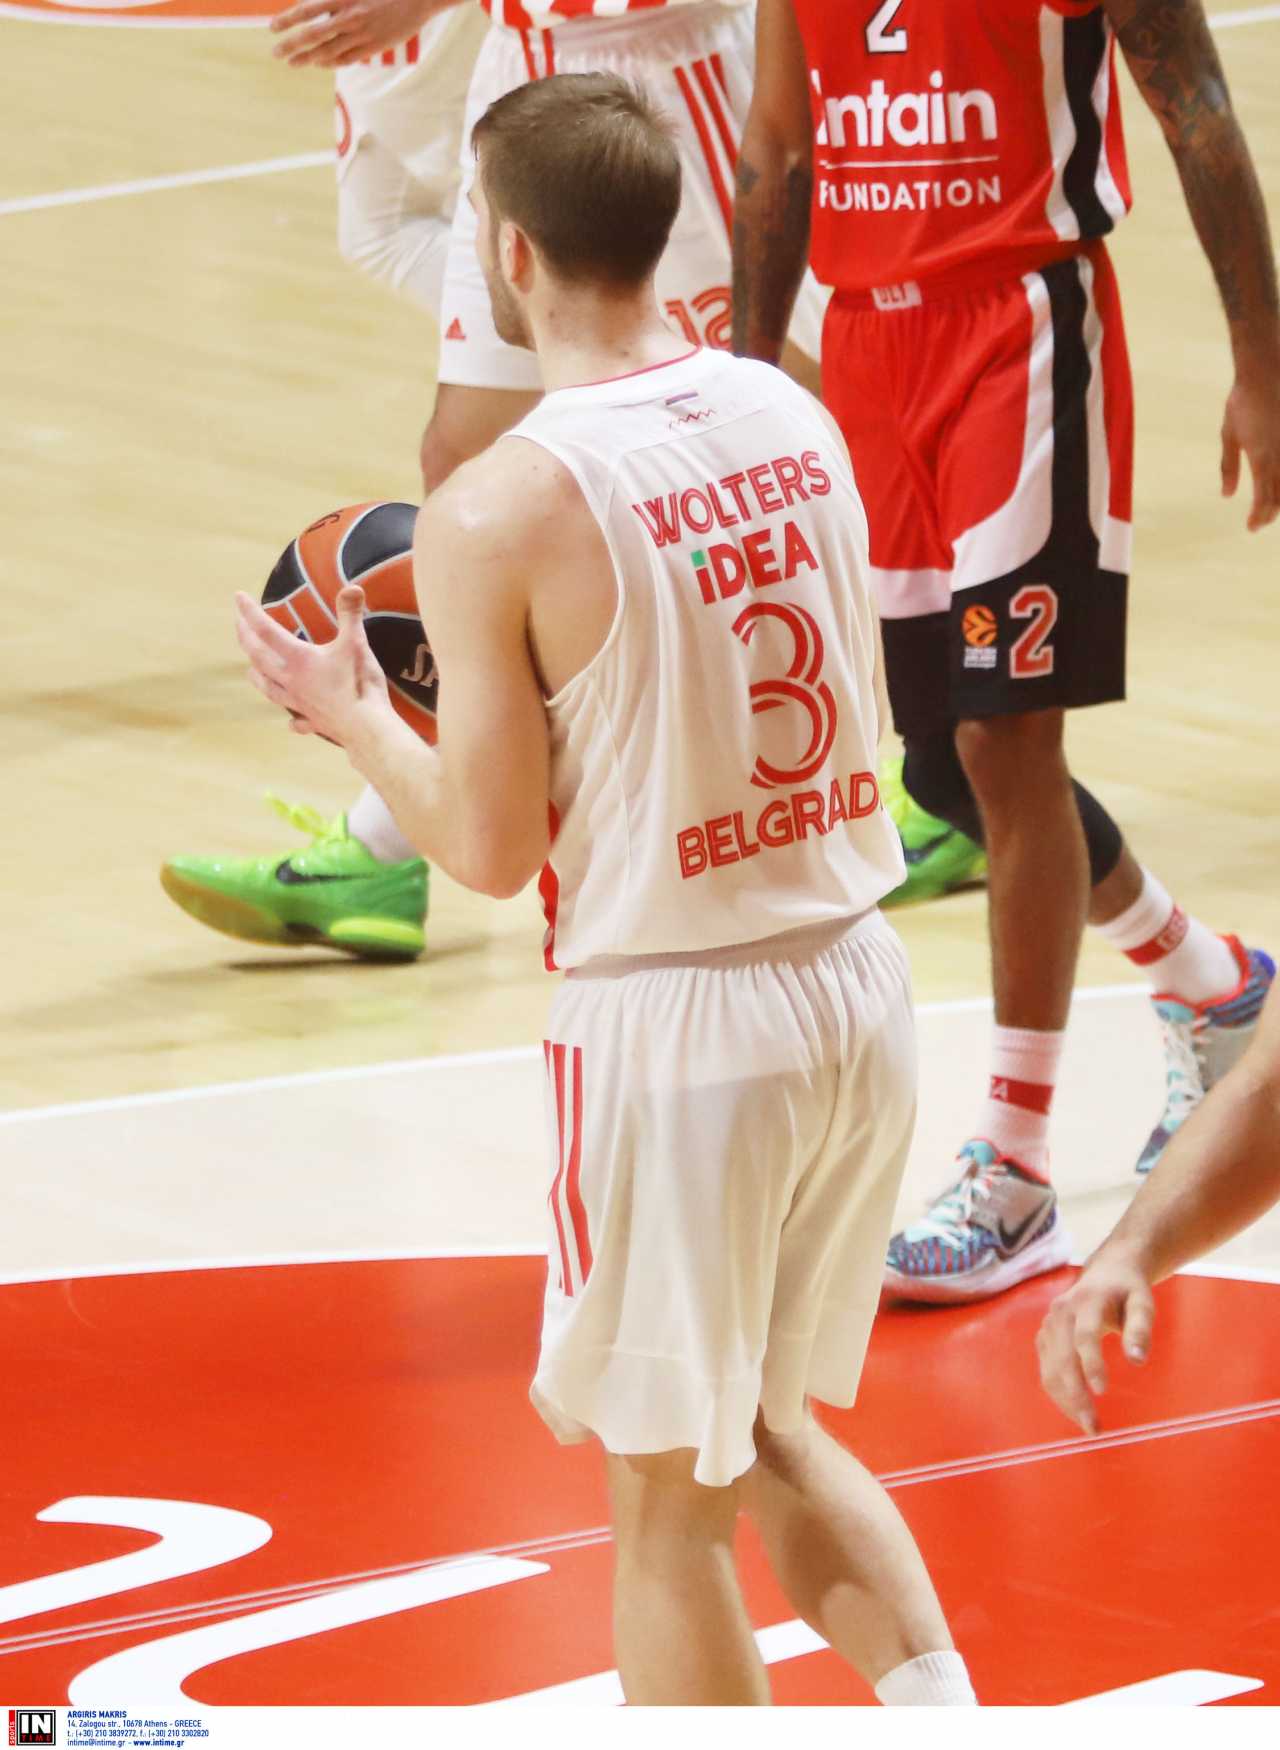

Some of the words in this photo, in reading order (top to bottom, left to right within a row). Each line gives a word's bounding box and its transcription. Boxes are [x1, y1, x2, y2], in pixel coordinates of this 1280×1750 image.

[811, 68, 998, 148] ntain
[633, 450, 832, 548] WOLTERS
[1009, 584, 1058, 679] 2
[731, 601, 838, 789] 3
[677, 771, 884, 880] BELGRAD
